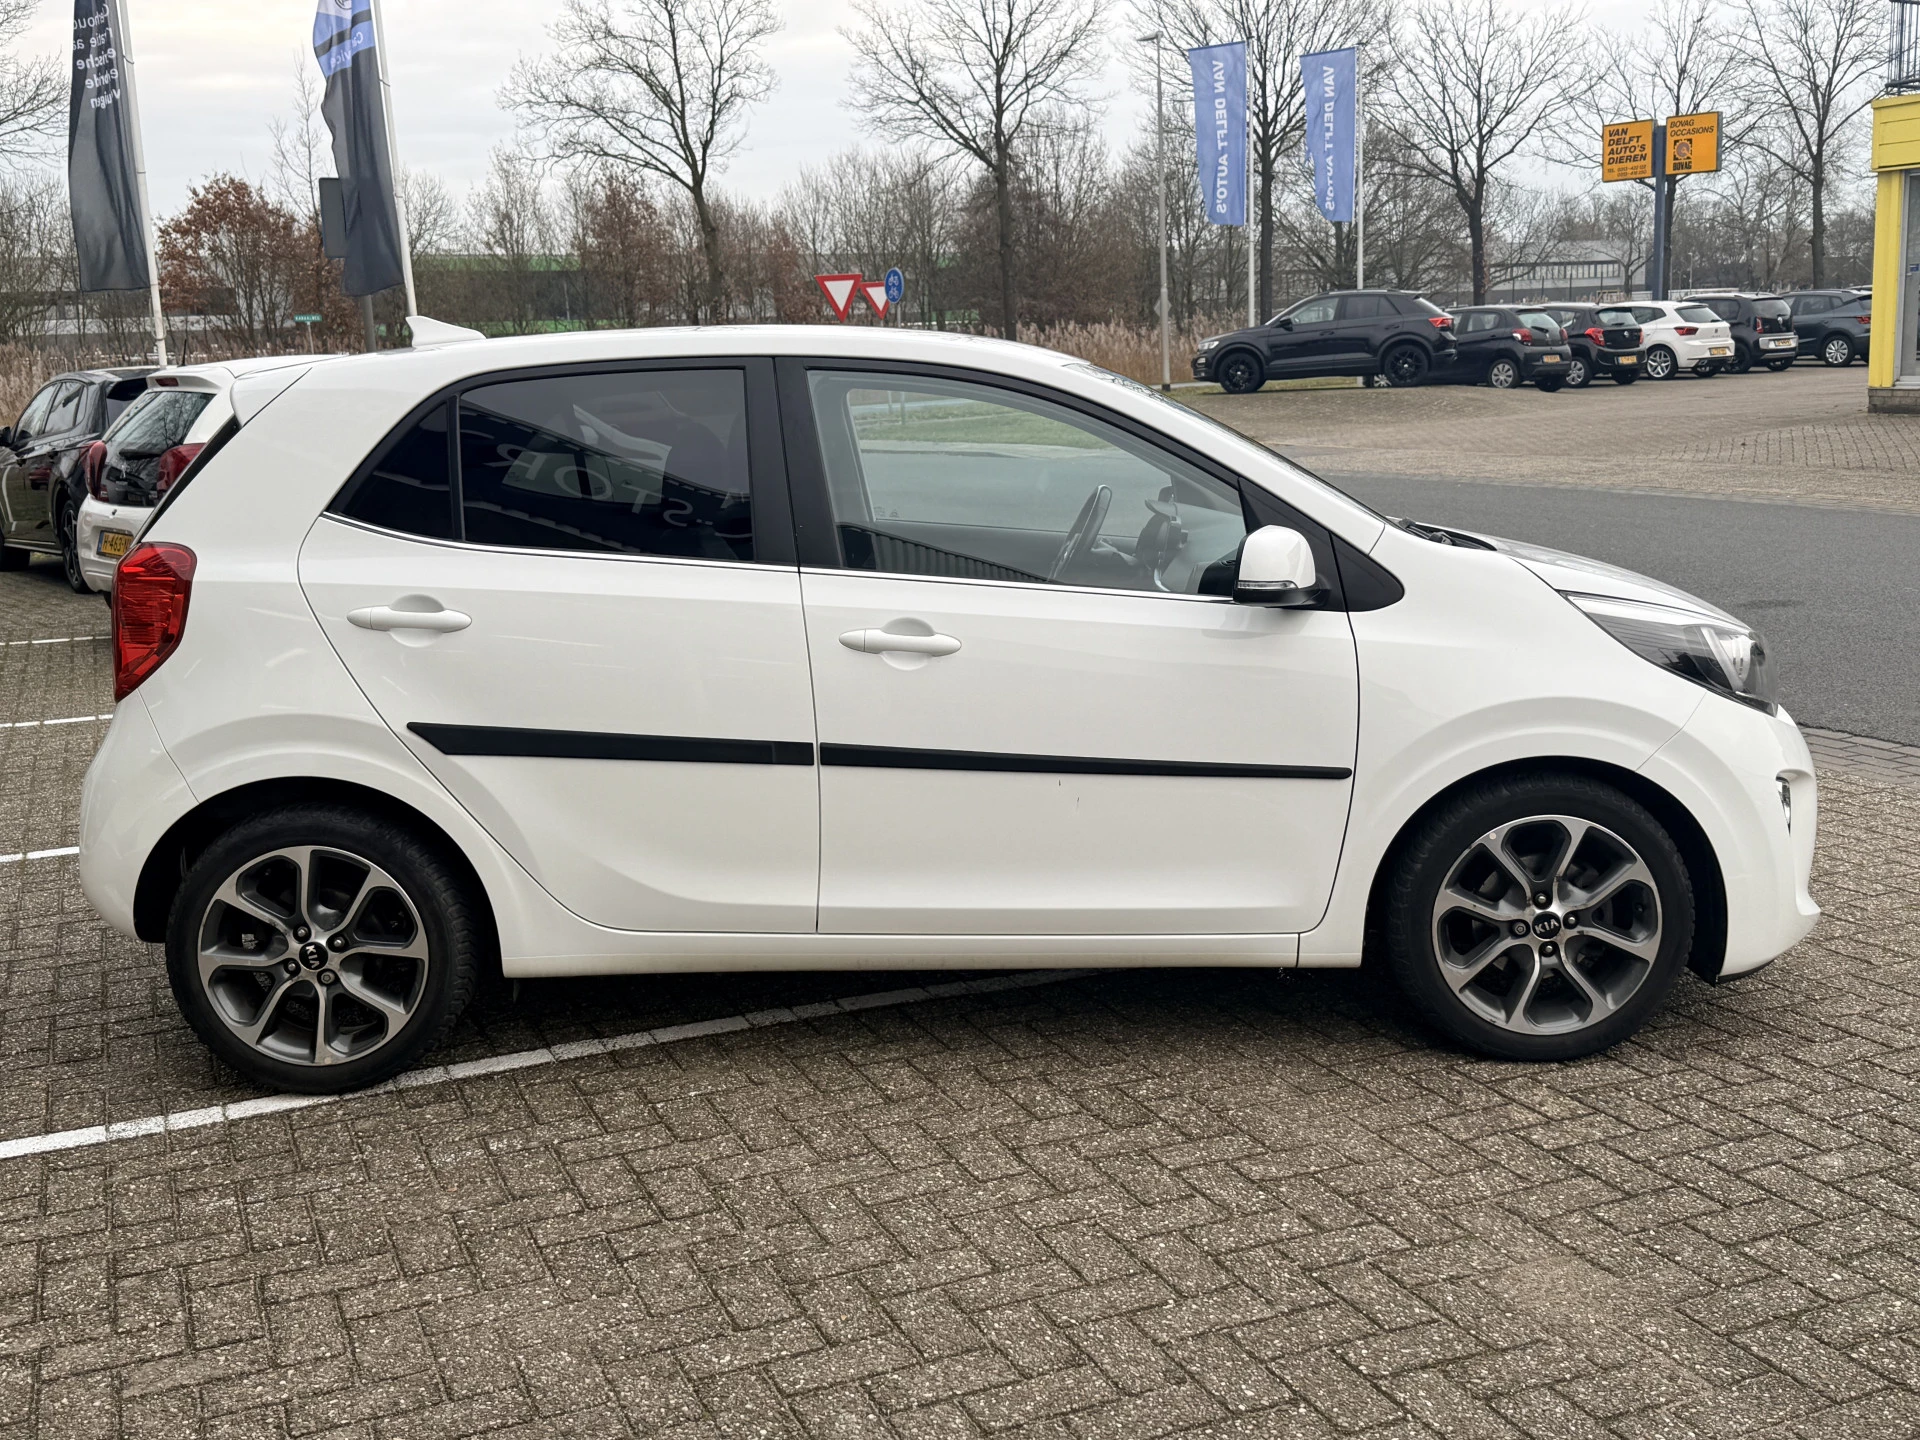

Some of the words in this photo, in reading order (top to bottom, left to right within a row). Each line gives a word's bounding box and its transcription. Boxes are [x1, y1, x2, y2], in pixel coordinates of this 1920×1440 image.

[1670, 119, 1694, 129] BOVAG
[1608, 128, 1628, 137] VAN
[1670, 125, 1714, 137] OCCASIONS
[1608, 135, 1642, 146] DELFT
[1608, 144, 1646, 156] AUTO'S
[1607, 153, 1647, 165] DIEREN
[1673, 161, 1692, 171] BOVAG
[1535, 919, 1559, 934] KIA
[305, 945, 320, 969] KIA
